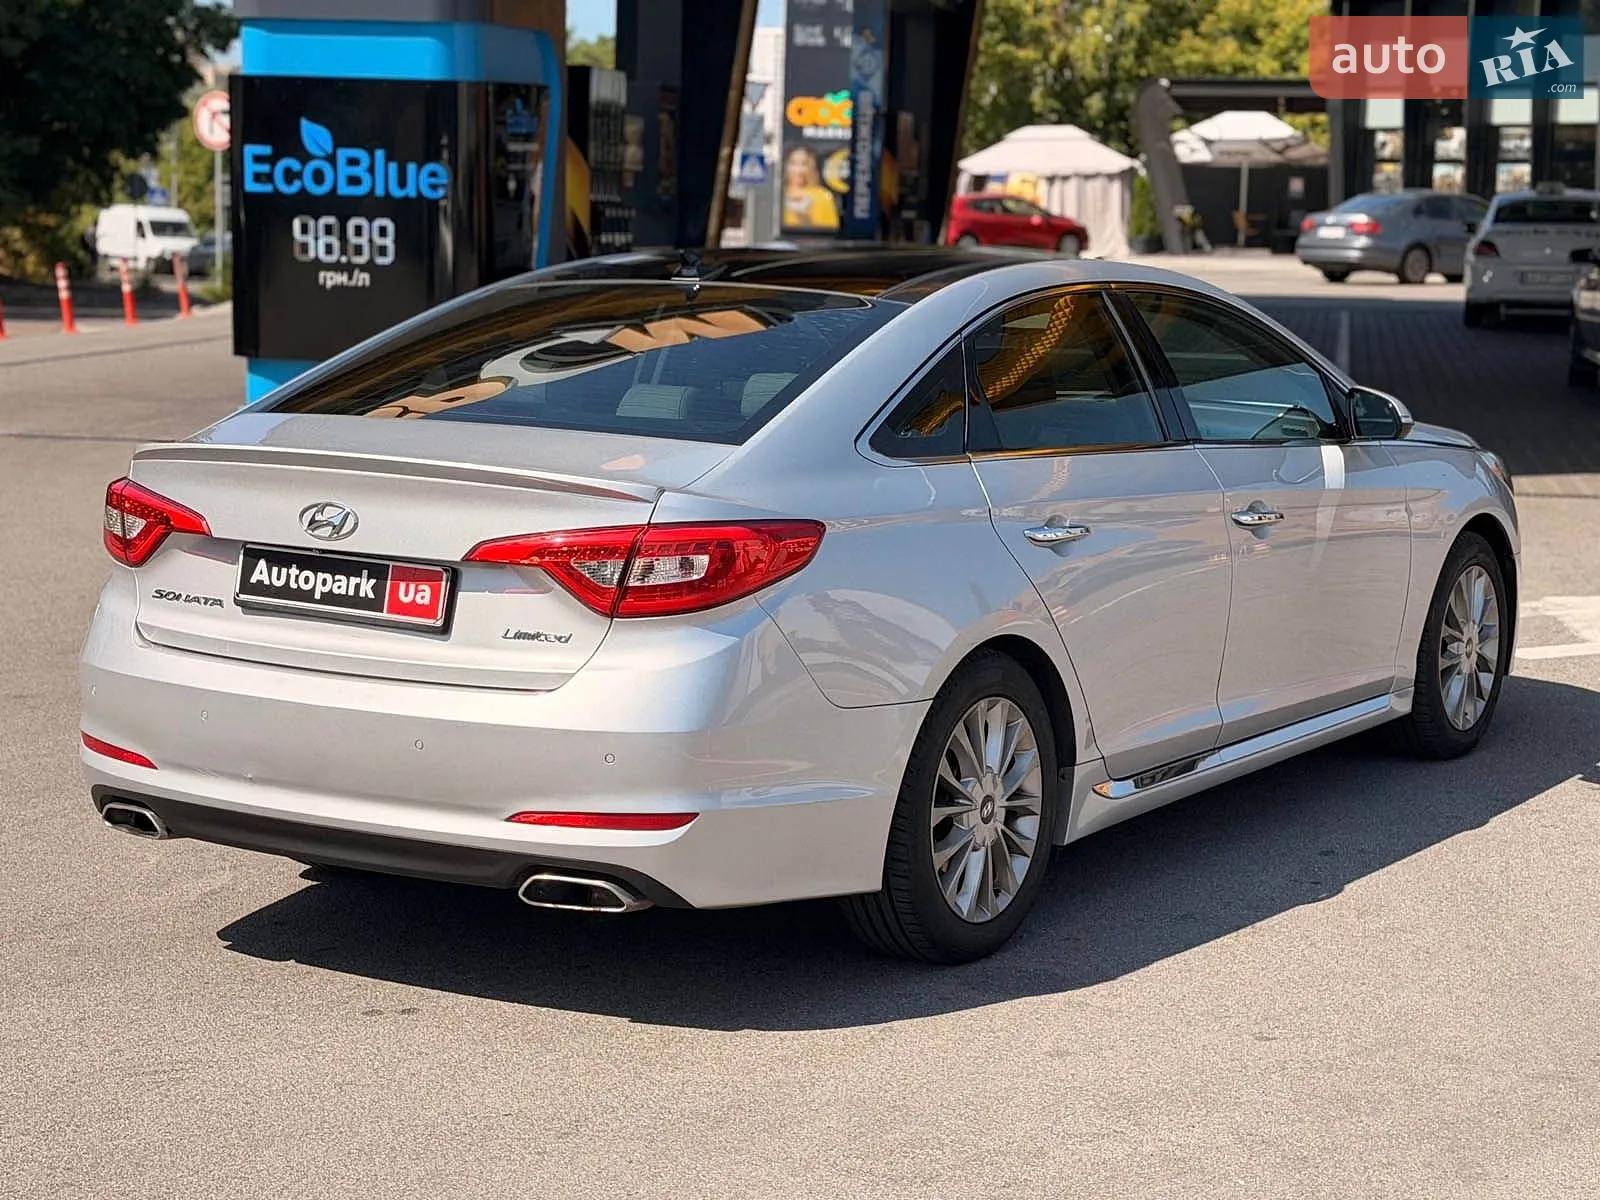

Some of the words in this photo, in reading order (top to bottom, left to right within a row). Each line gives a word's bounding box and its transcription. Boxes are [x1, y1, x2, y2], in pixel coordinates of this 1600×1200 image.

[243, 143, 450, 200] EcoBlue
[250, 557, 376, 600] Autopark
[398, 580, 433, 606] ua
